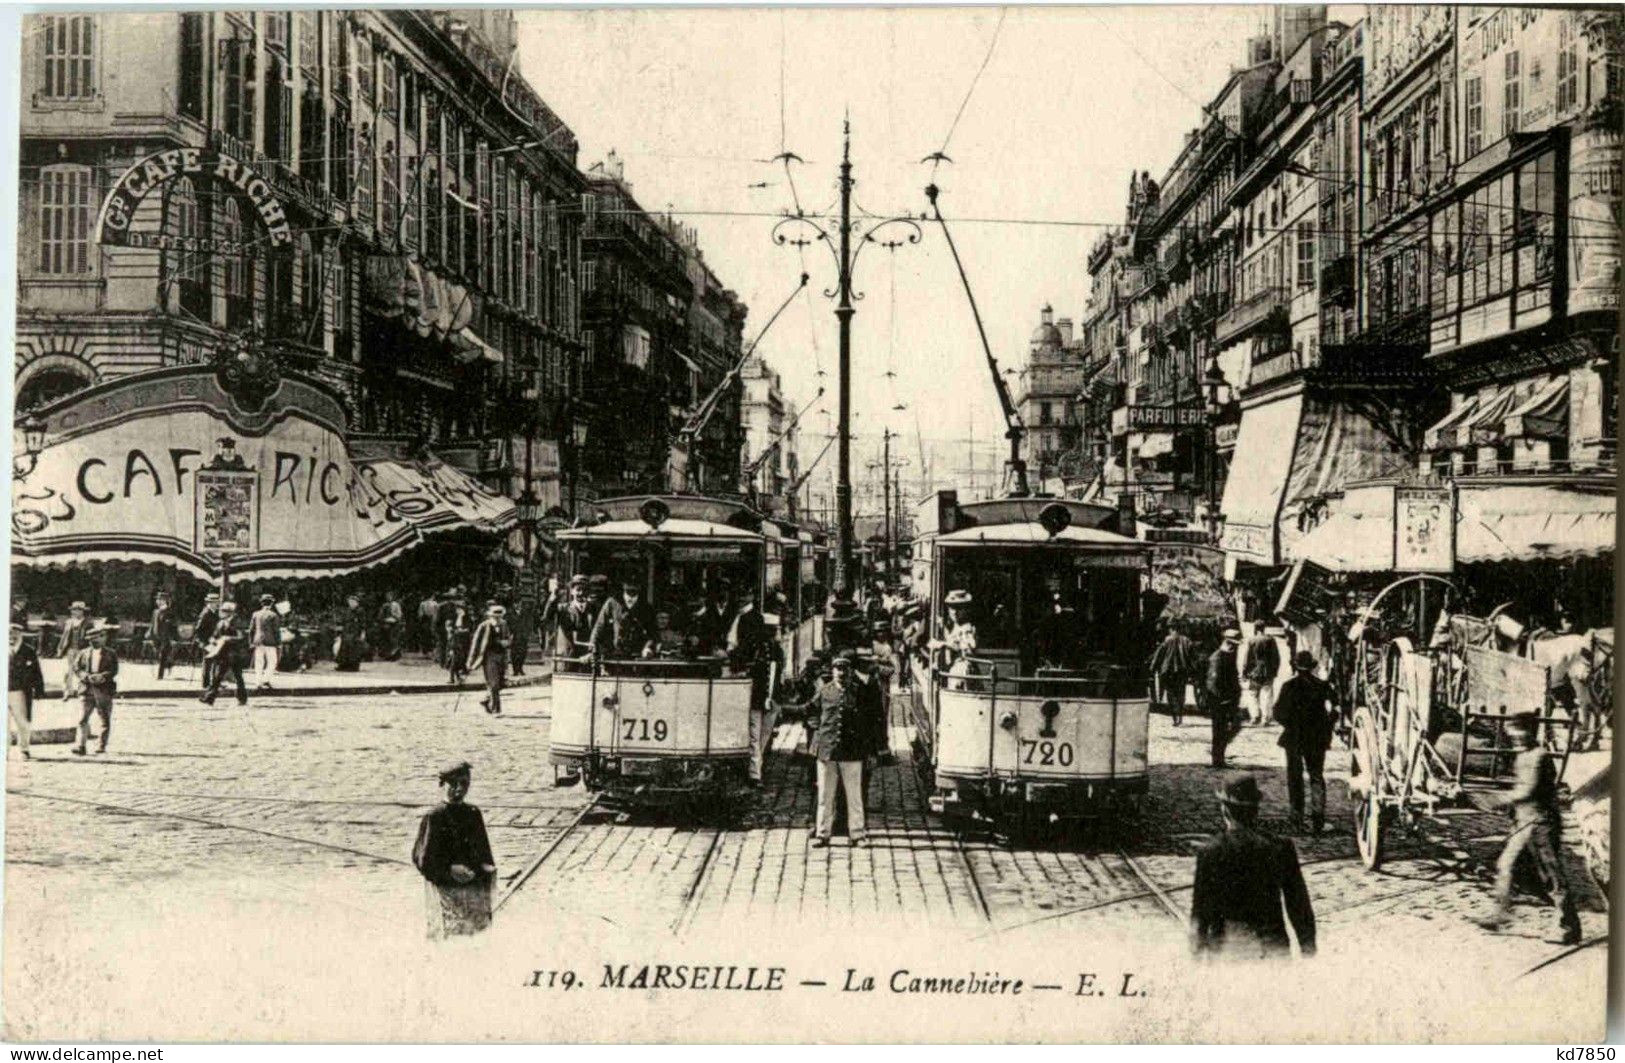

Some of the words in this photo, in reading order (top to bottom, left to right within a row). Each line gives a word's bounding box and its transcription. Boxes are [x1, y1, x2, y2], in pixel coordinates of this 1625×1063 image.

[213, 152, 293, 247] RICHE
[76, 448, 202, 504] CAF
[622, 718, 668, 742] 719
[1020, 738, 1074, 767] 720
